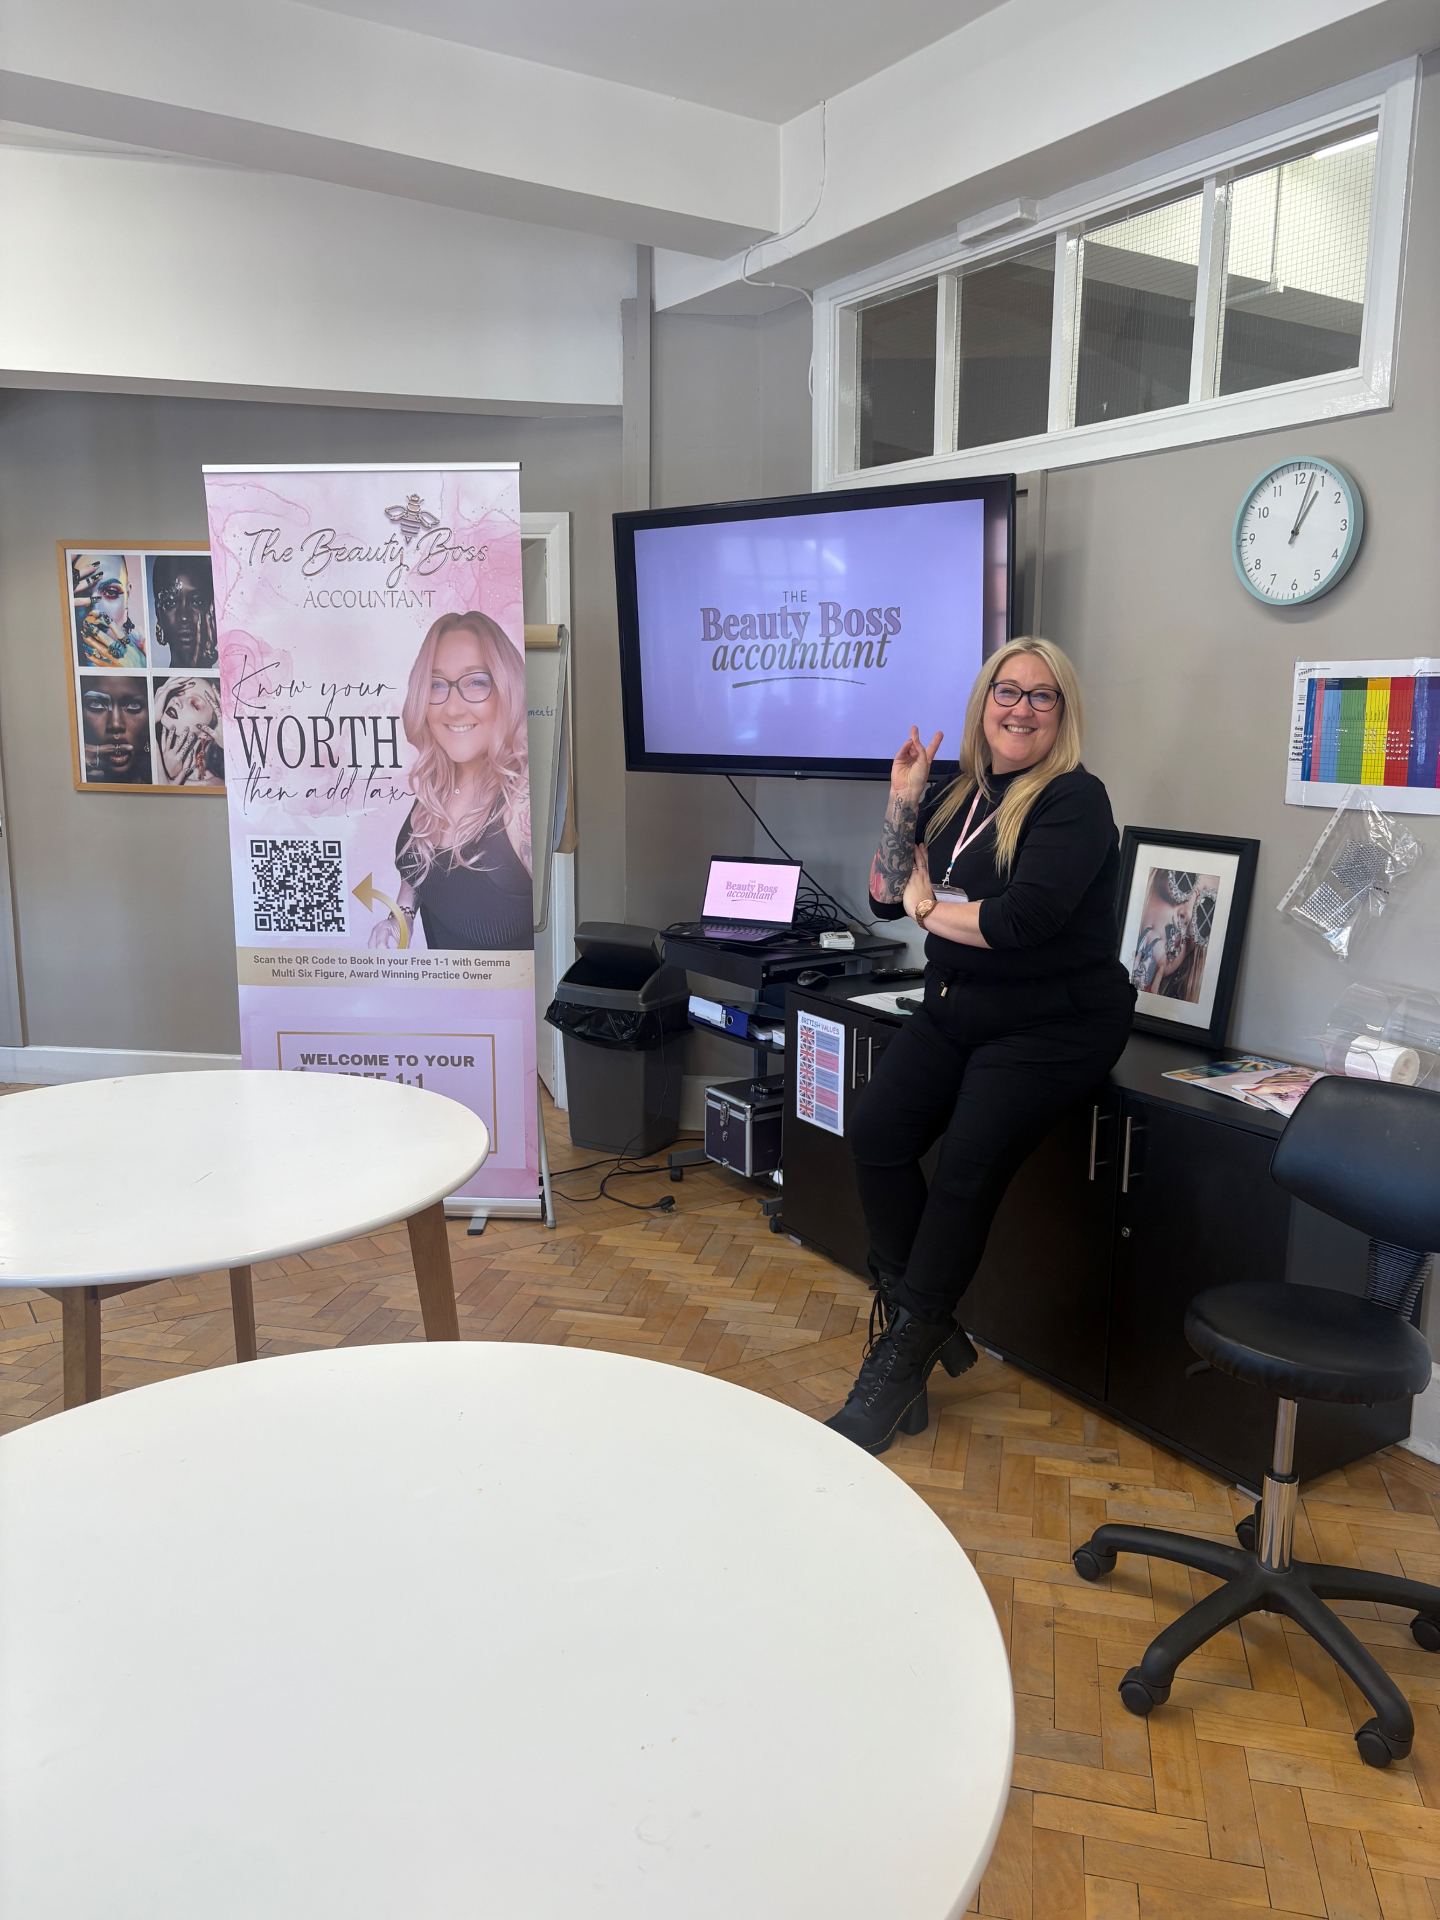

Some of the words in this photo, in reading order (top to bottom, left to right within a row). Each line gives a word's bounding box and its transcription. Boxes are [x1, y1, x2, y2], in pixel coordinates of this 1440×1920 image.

[1294, 472, 1306, 485] 12
[1320, 475, 1325, 488] 1
[1273, 485, 1282, 498] 11
[1334, 491, 1341, 504] 2
[1258, 506, 1270, 518] 10
[1340, 518, 1348, 532] 3
[1248, 532, 1256, 545] 9
[244, 528, 294, 566] The
[300, 528, 410, 588] Beauty
[416, 527, 488, 576] Boss
[1331, 548, 1338, 560] 4
[1254, 558, 1262, 570] 8
[1270, 573, 1277, 586] 7
[1313, 569, 1320, 582] 5
[1290, 578, 1298, 591] 6
[303, 590, 436, 608] ACCOUNTANT
[782, 590, 808, 603] THE
[700, 605, 810, 646] Beauty
[818, 601, 902, 637] Boss
[712, 634, 892, 672] accountant
[232, 654, 312, 718] Know
[320, 682, 397, 721] your
[234, 715, 402, 769] WORTH
[232, 762, 298, 816] then
[305, 767, 358, 817] add
[757, 883, 778, 894] Boss
[253, 954, 276, 964] Scan
[278, 955, 293, 964] the
[295, 956, 309, 965] QR
[311, 956, 336, 964] Code
[338, 956, 348, 965] to
[350, 956, 374, 965] Book
[376, 956, 385, 965] In
[387, 958, 408, 967] your
[410, 957, 432, 966] Free
[434, 957, 449, 966] 1-1
[452, 958, 472, 966] with
[474, 958, 511, 967] Gemma
[272, 968, 296, 978] Multi
[298, 969, 312, 978] Six
[314, 969, 347, 979] Figure,
[349, 969, 379, 978] Award
[381, 970, 420, 980] Winning
[421, 970, 460, 979] Practice
[462, 971, 493, 980] Owner
[300, 1054, 389, 1066] WELCOME
[394, 1054, 419, 1067] TO
[424, 1055, 475, 1068] YOUR
